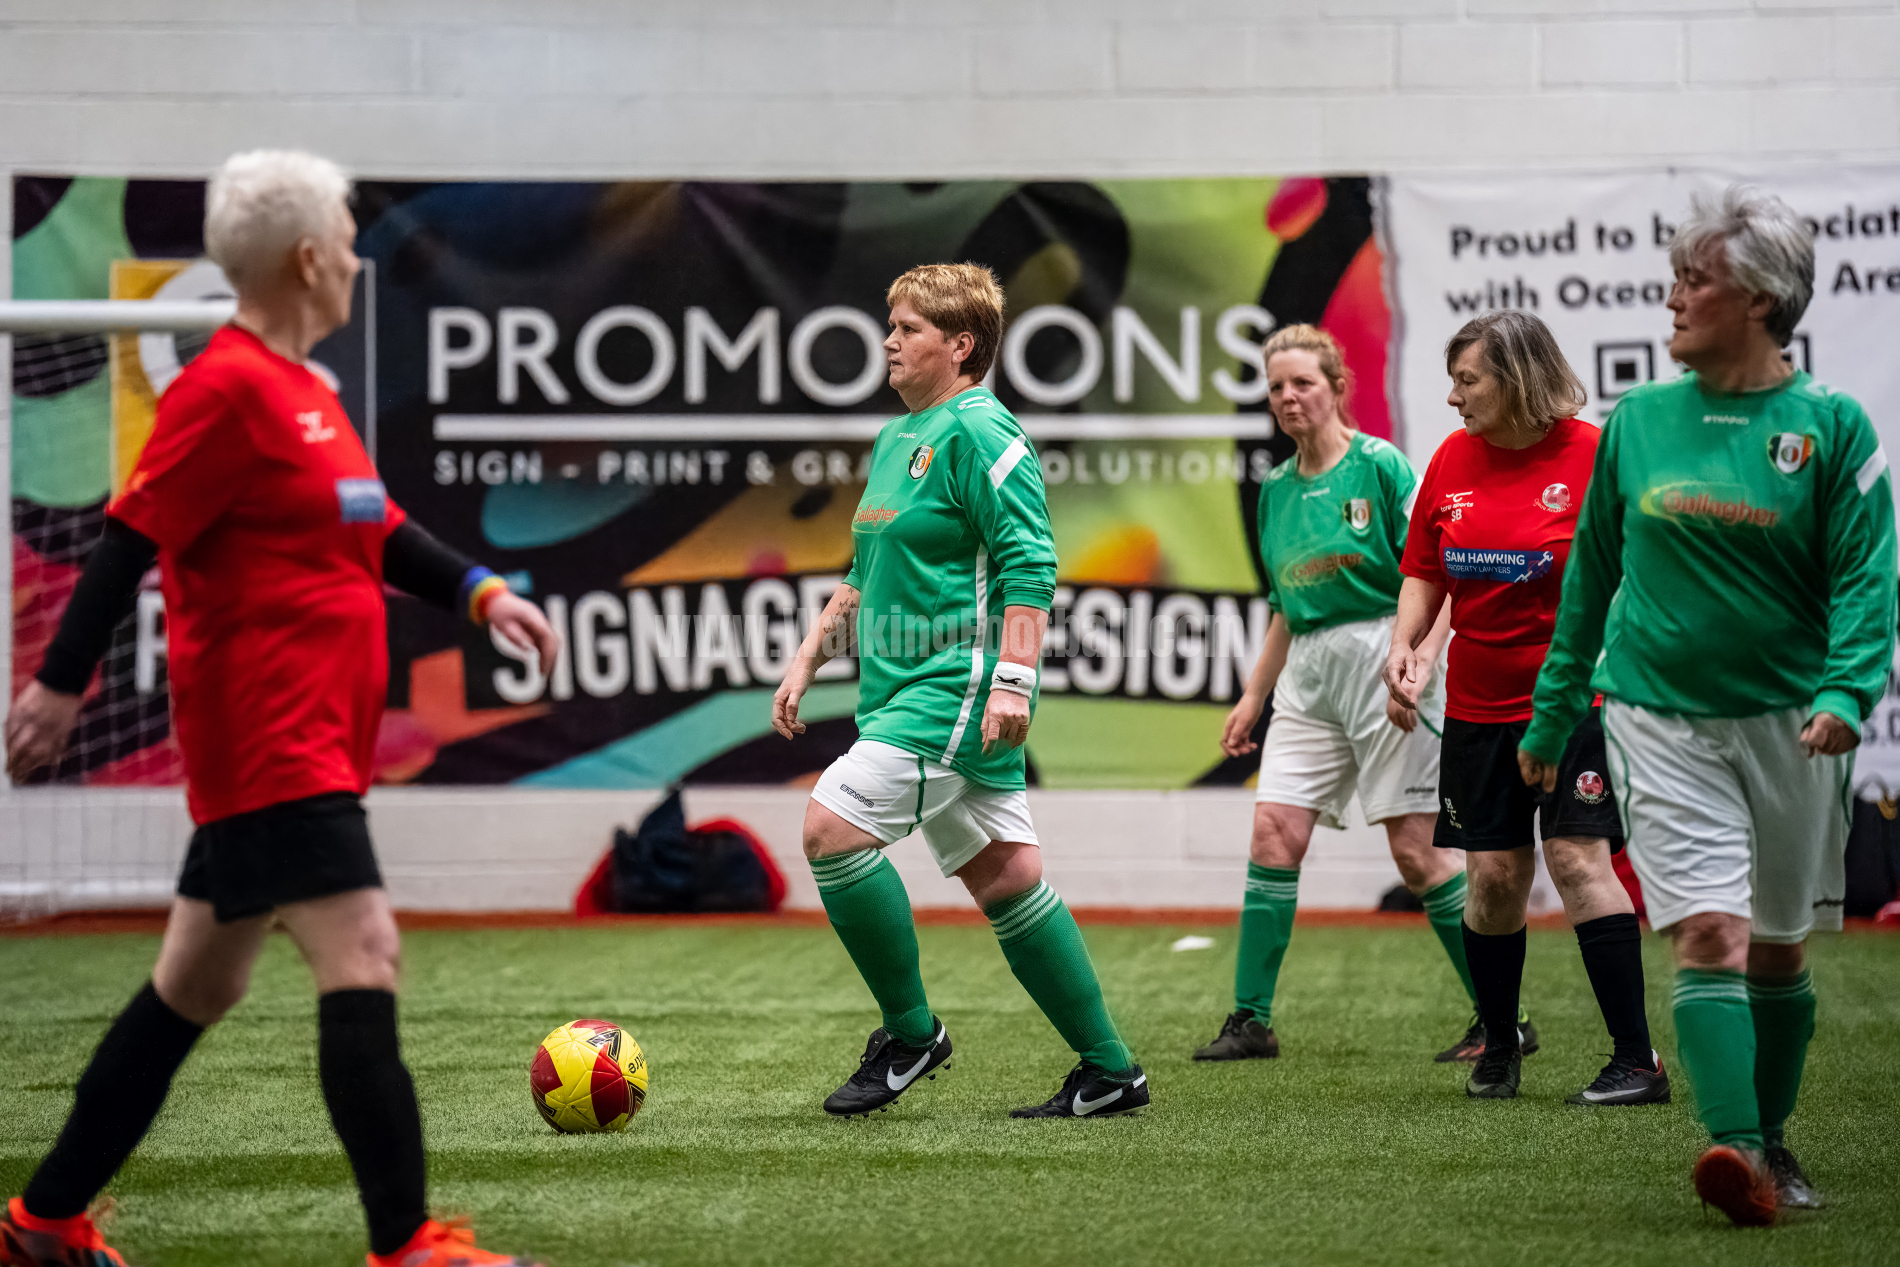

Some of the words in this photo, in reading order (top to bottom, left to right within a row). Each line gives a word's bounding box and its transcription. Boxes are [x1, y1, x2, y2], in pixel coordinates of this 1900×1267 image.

[1450, 217, 1577, 261] Proud
[1595, 221, 1636, 252] to
[1447, 275, 1541, 312] with
[1558, 275, 1676, 309] Ocea
[428, 305, 1276, 405] PROMOONS
[433, 449, 543, 486] SIGN
[598, 449, 731, 486] PRINT
[745, 449, 775, 486] &
[1041, 448, 1273, 485] OLUTIONS
[1451, 508, 1462, 523] SB
[1445, 550, 1466, 563] SAM
[1468, 552, 1526, 566] HAWKING
[1446, 563, 1478, 573] PROPERTY
[1479, 565, 1512, 575] LAWYERS
[1040, 586, 1270, 702] ESIGN
